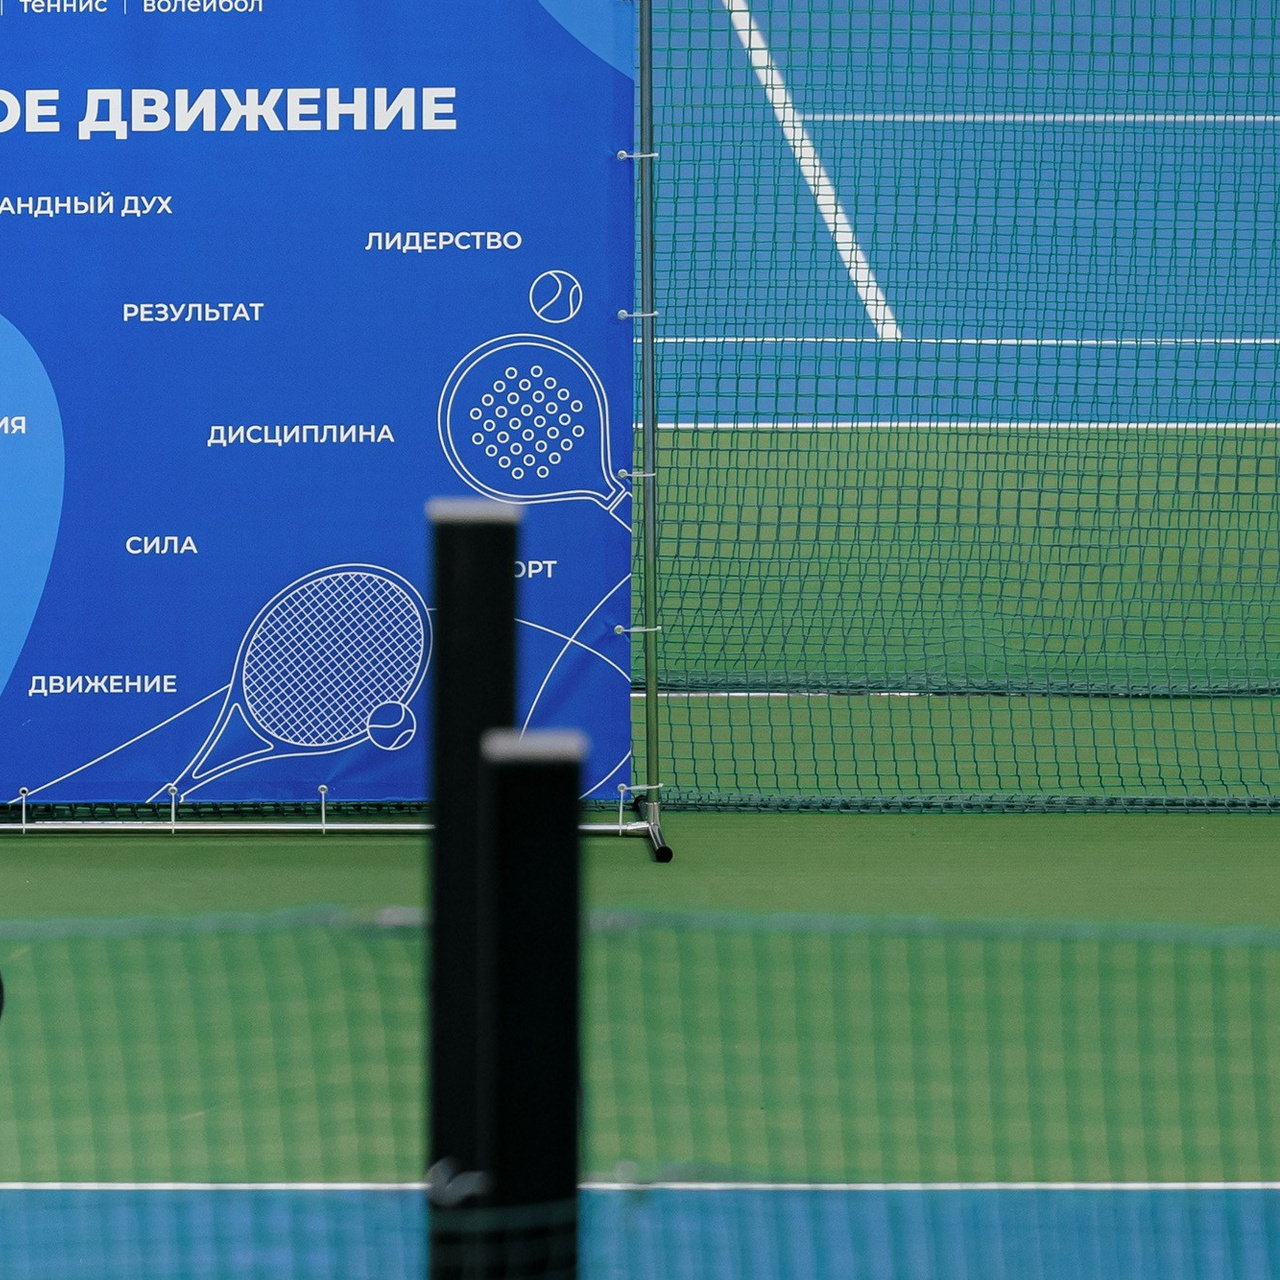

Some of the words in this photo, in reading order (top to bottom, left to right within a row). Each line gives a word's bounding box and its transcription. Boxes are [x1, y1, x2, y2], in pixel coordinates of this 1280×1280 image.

[78, 87, 457, 140] ДВИЖЕНИЕ
[120, 195, 173, 218] ДУХ
[365, 231, 522, 254] ЛИДЕРСТВО
[123, 302, 265, 322] РЕЗУЛЬТАТ
[207, 424, 395, 447] ДИСЦИПЛИНА
[125, 535, 198, 556] СИЛА
[514, 560, 558, 579] ОРТ
[28, 674, 177, 697] ДВИЖЕНИЕ
